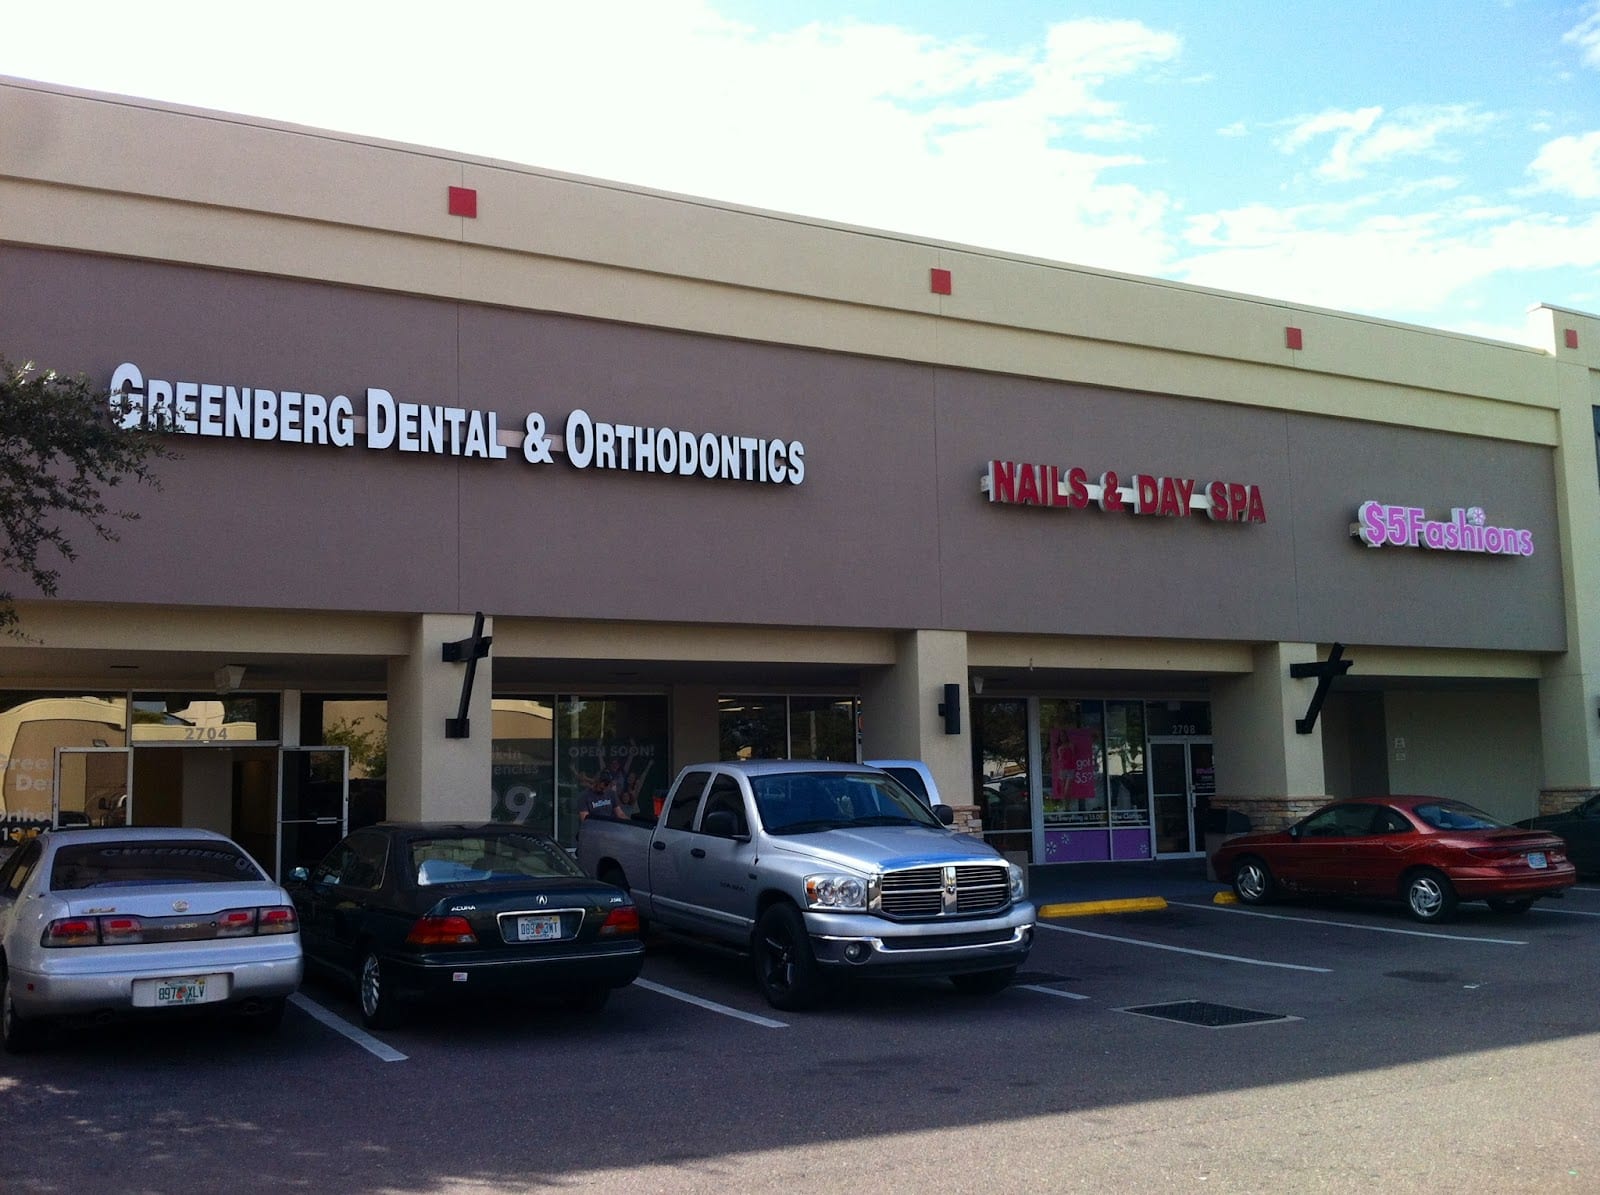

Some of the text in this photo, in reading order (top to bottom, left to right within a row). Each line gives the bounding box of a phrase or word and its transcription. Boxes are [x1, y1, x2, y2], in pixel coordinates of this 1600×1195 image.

[109, 362, 805, 485] GREENBERG DENTAL & ORTHODONTICS
[988, 460, 1266, 523] NAILS & DAY SPA
[185, 727, 228, 740] 2704
[1172, 724, 1196, 734] 2708
[568, 745, 655, 757] OPEN SOON!
[1076, 757, 1091, 770] got
[158, 985, 205, 1000] 897 XLV
